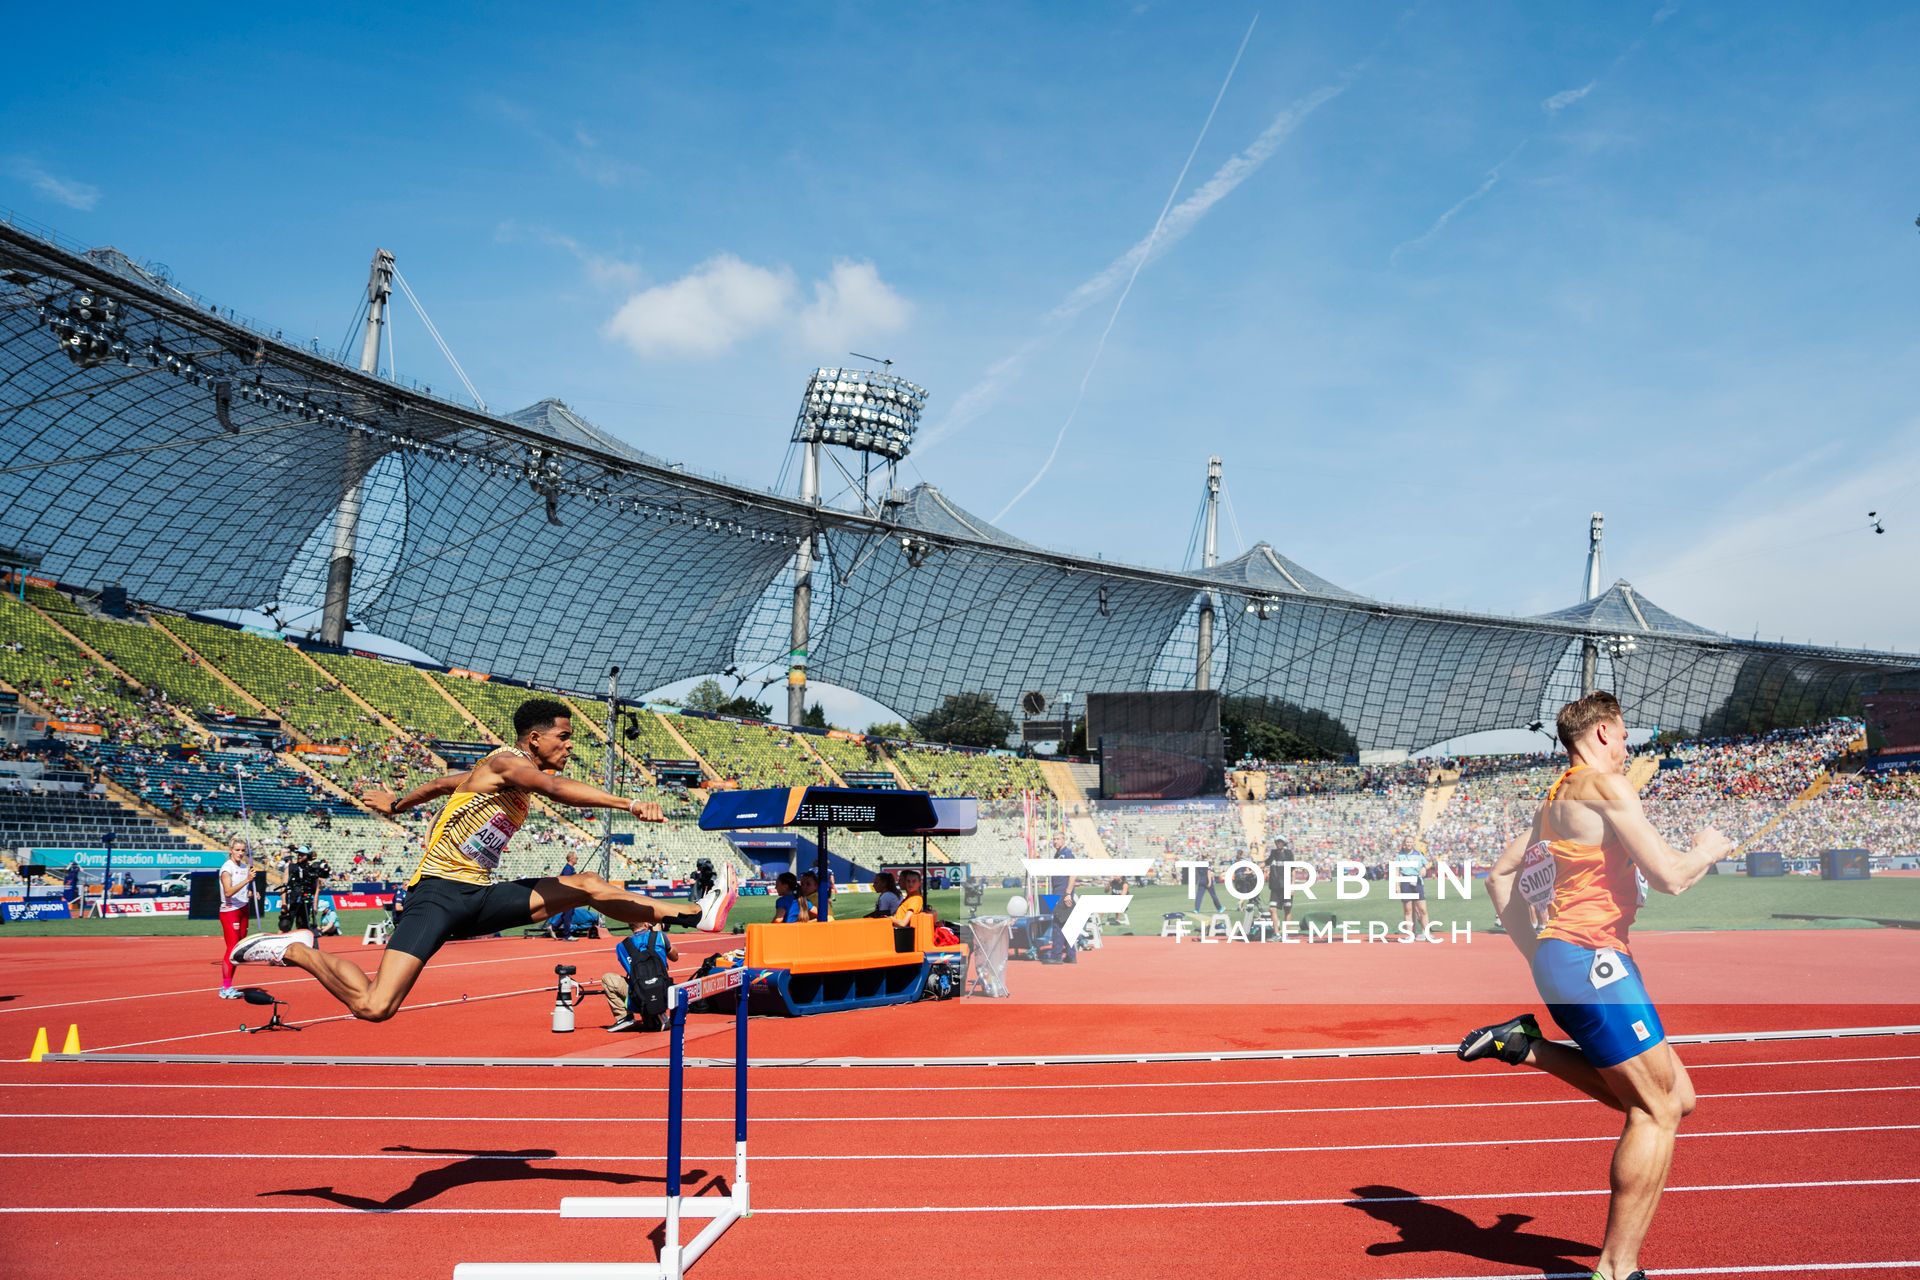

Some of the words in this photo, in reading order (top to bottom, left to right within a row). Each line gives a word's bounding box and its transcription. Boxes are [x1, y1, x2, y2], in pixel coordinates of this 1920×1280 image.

[830, 805, 876, 822] THROW
[74, 852, 154, 865] Olympastadion
[156, 853, 202, 865] München
[1520, 863, 1556, 894] SMIDT
[109, 904, 140, 912] SPAR
